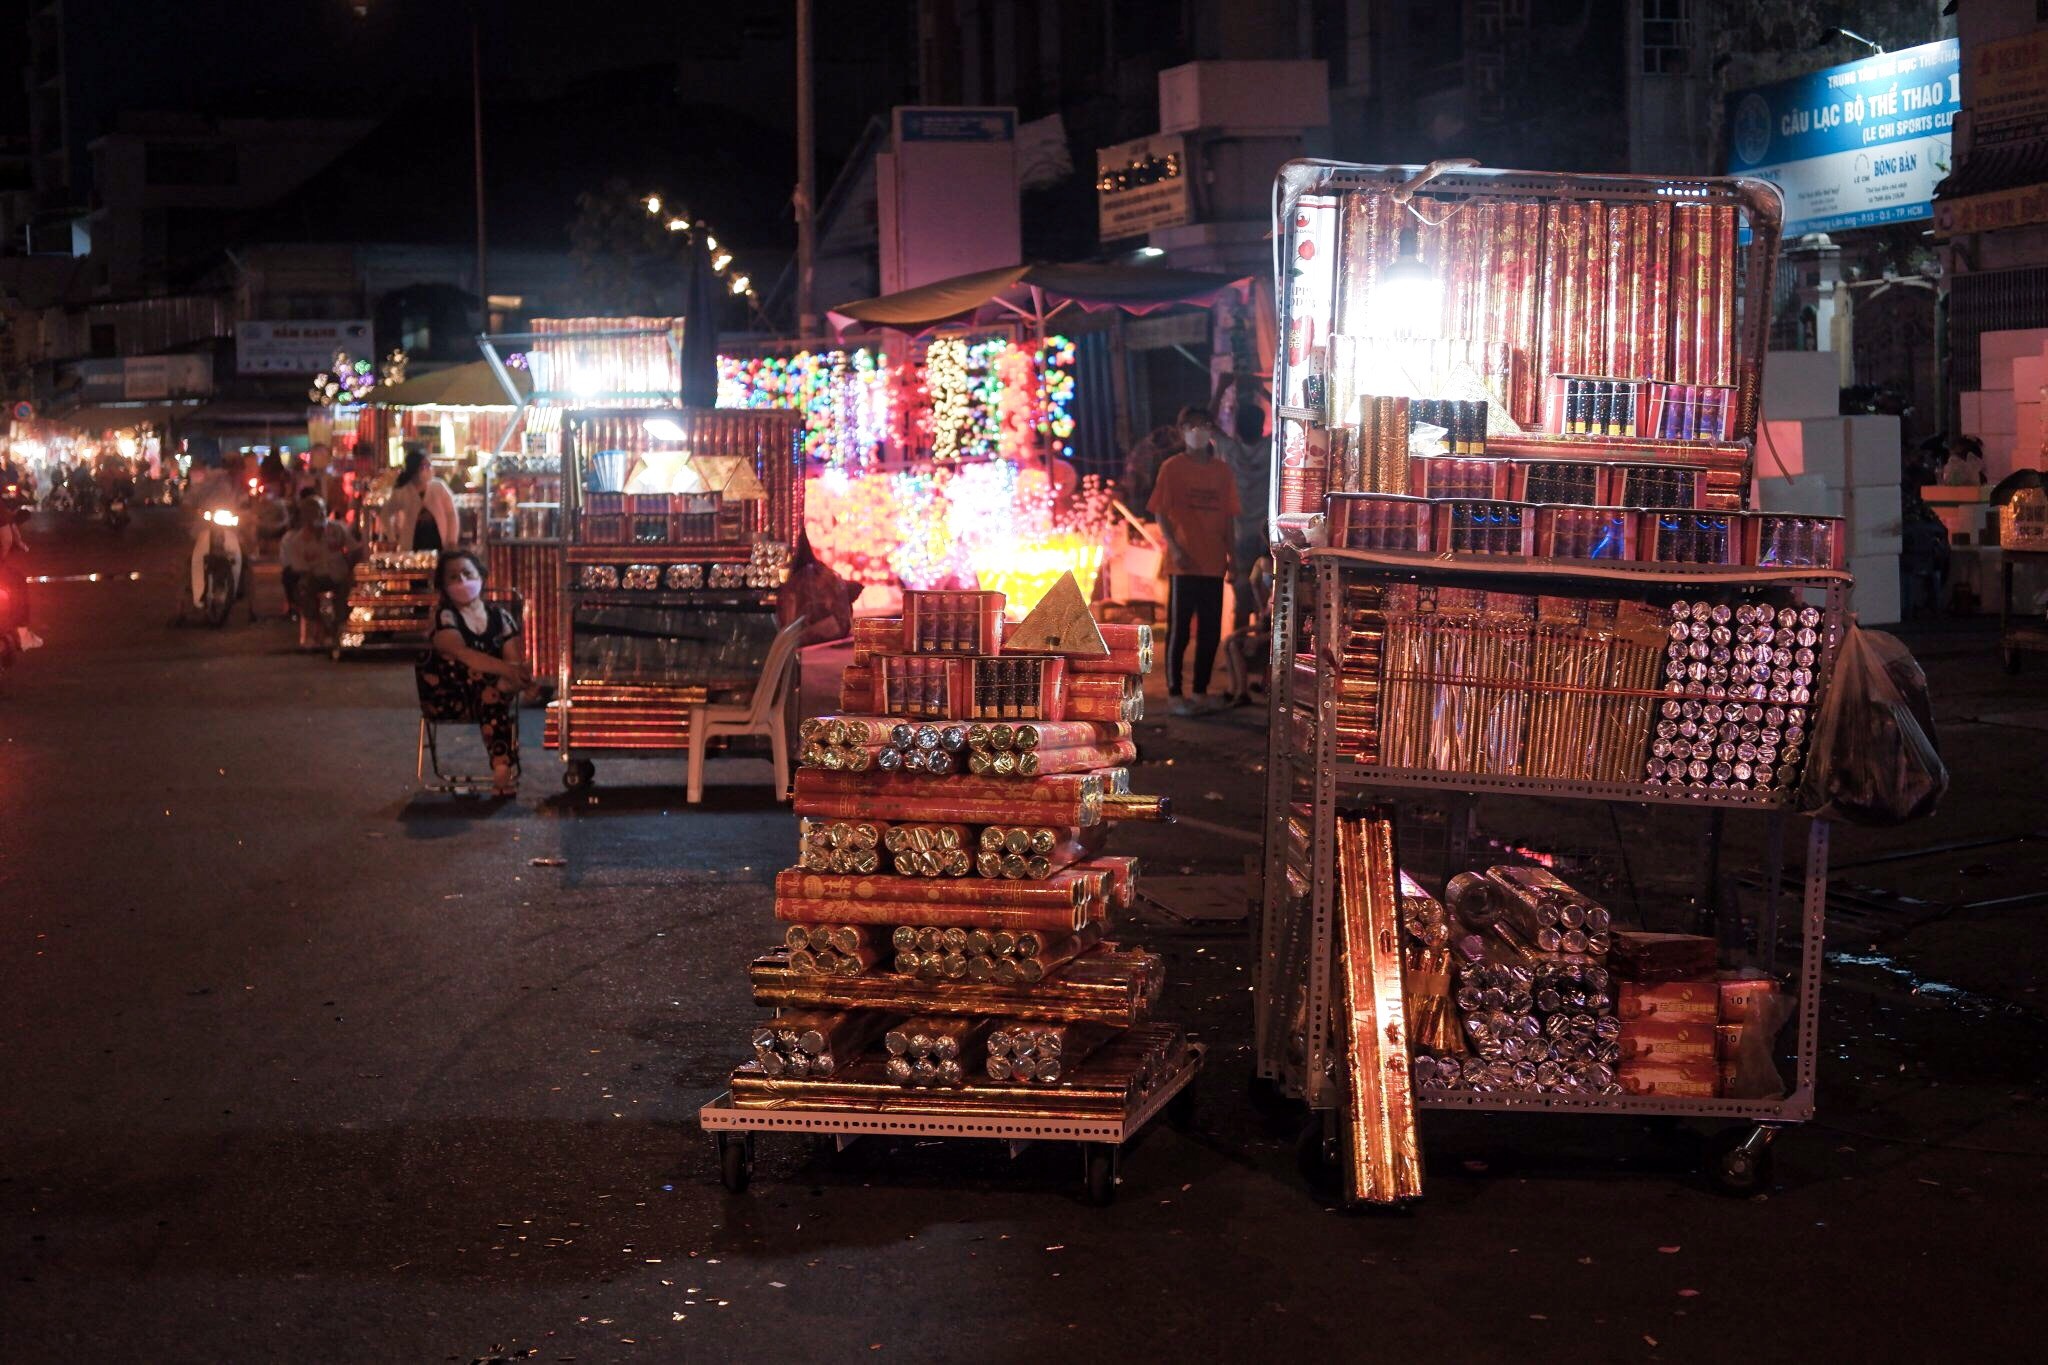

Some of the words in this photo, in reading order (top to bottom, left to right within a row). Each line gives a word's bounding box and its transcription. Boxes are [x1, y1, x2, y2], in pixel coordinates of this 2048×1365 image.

[1781, 108, 1809, 136] CÂU
[1813, 103, 1840, 133] LẠC
[1844, 94, 1865, 126] BỘ
[1868, 82, 1898, 118] THỂ
[1901, 82, 1943, 111] THAO
[1878, 122, 1895, 139] CHI
[1897, 115, 1932, 135] SPORTS
[1731, 996, 1743, 1005] 10
